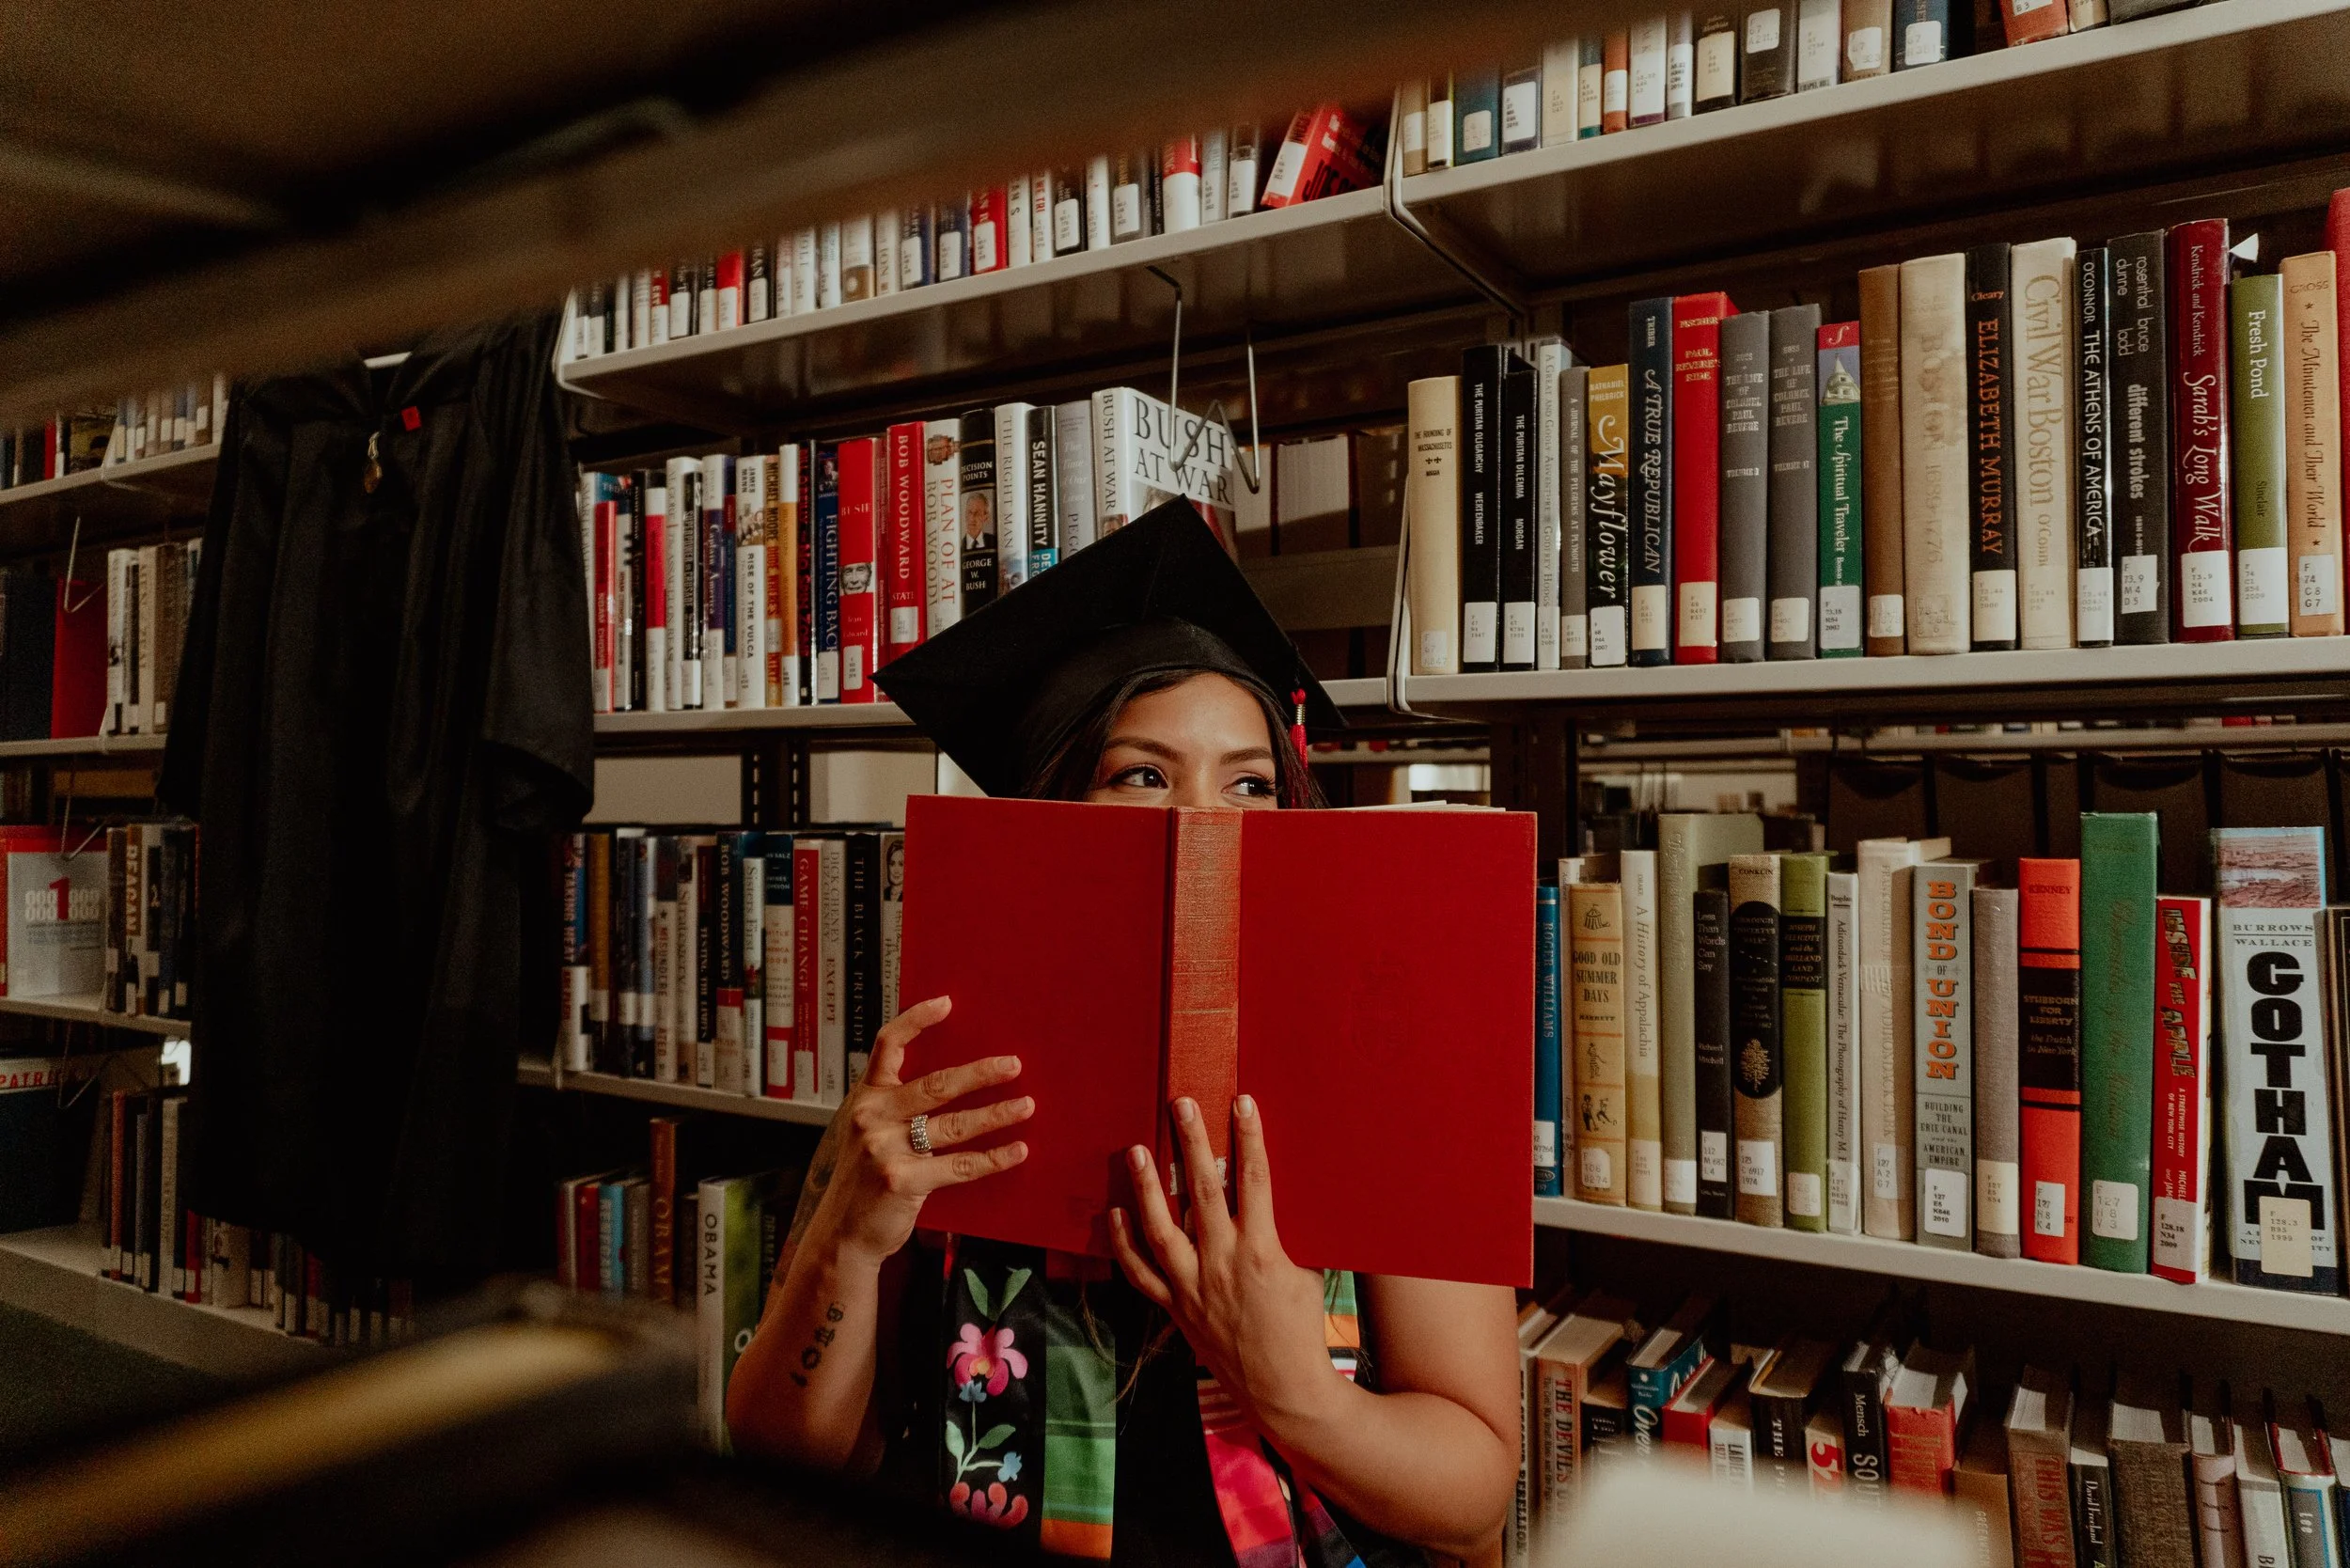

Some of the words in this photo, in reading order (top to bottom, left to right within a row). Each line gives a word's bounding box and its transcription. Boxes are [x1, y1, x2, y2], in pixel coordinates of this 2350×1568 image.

[2116, 258, 2133, 297] dunne
[2136, 256, 2154, 310] rosenthal
[2190, 244, 2204, 290] Kendrick
[2082, 261, 2096, 324] O'CONNOR
[2192, 292, 2204, 309] and
[2084, 329, 2101, 366] THE
[2117, 327, 2134, 357] ladd
[2137, 316, 2154, 353] bruce
[2192, 309, 2206, 357] Kendrick
[2248, 309, 2268, 355] Fresh
[2300, 320, 2320, 343] The
[1684, 348, 1713, 358] PAUL
[1774, 368, 1790, 379] THE
[1793, 364, 1811, 375] LIFE
[1474, 382, 1483, 398] THE
[1590, 379, 1625, 391] NATHANIEL
[1590, 390, 1625, 402] PHILBRICK
[1645, 368, 1662, 393] A
[1978, 318, 2001, 451] ELIZABETH
[2249, 358, 2269, 399] Pond
[2302, 347, 2321, 422] Minutemen
[1103, 394, 1115, 440] BUSH
[1474, 398, 1483, 431] PURITAN
[1780, 401, 1803, 414] PAUL
[2084, 369, 2102, 433] ATHENS
[2127, 384, 2149, 444] different
[2183, 371, 2218, 436] Sarah's
[1133, 395, 1229, 469] BUSH
[1515, 414, 1525, 430] THE
[1645, 394, 1662, 446] TRUE
[1834, 416, 1850, 442] The
[2304, 423, 2324, 447] and
[898, 434, 910, 468] BOB
[1032, 440, 1045, 479] SEAN
[1104, 446, 1115, 466] AT
[1418, 441, 1453, 452] MASSACHUSETTS
[1474, 431, 1484, 474] OLIGARCHY
[1515, 431, 1525, 463] PURITAN
[2083, 437, 2102, 461] OF
[2182, 444, 2217, 486] Long
[963, 471, 988, 482] POINTS
[1003, 455, 1013, 509] RIGHT
[1134, 447, 1165, 483] AT
[1175, 463, 1233, 506] WAR
[1515, 463, 1525, 499] DILEMMA
[1570, 460, 1578, 474] THE
[1831, 444, 1852, 501] Spiritual
[2128, 447, 2151, 500] strokes
[941, 478, 955, 533] PLAN
[1104, 471, 1117, 510] WAR
[1571, 477, 1579, 516] PILGRIMS
[1590, 414, 1629, 599] Mayflower
[1980, 455, 2003, 556] MURRAY
[2085, 464, 2103, 537] AMERICA
[2256, 479, 2267, 518] Sinclair
[2307, 485, 2326, 528] World
[899, 474, 910, 579] WOODWARD
[1033, 483, 1048, 546] HANNITY
[1474, 492, 1484, 545] WERTENBAKER
[1639, 448, 1663, 574] REPUBLICAN
[1834, 504, 1850, 554] Traveler
[2187, 484, 2221, 553] Walk
[1003, 513, 1013, 548] MAN
[1515, 518, 1525, 550] MORGAN
[941, 541, 955, 570] OF
[962, 557, 993, 570] GEORGE
[1571, 533, 1579, 572] PLYMOUTH
[747, 582, 754, 595] OF
[965, 581, 986, 591] BUSH
[720, 844, 729, 877] BOB
[2029, 885, 2074, 895] KENNEY
[1637, 905, 1649, 917] A
[1697, 924, 1719, 933] Than
[1926, 880, 1959, 961] BOND
[2232, 923, 2314, 932] BURROWS
[720, 882, 730, 981] WOODWARD
[1543, 922, 1555, 967] ROGER
[1634, 921, 1650, 973] History
[1699, 935, 1726, 946] Words
[1837, 919, 1847, 969] Adirondack
[2234, 938, 2313, 947] WALLACE
[1573, 951, 1596, 964] GOOD
[1601, 951, 1622, 965] OLD
[1697, 949, 1716, 958] Can
[1698, 961, 1714, 971] Say
[1936, 965, 1948, 975] OF
[1575, 969, 1618, 984] SUMMER
[1638, 974, 1651, 990] of
[1543, 972, 1556, 1039] WILLIAMS
[1583, 989, 1610, 1003] DAYS
[2040, 1006, 2062, 1015] FOR
[1634, 991, 1653, 1058] Appalachia
[1837, 1023, 1848, 1041] The
[1926, 979, 1959, 1081] UNION
[1835, 1043, 1847, 1100] Photography
[1838, 1101, 1847, 1110] of
[1924, 1101, 1965, 1114] BUILDING
[1936, 1114, 1952, 1123] THE
[2178, 1094, 2186, 1133] STREETWISE
[1836, 1110, 1848, 1139] Henry
[1920, 1122, 1940, 1134] ERIE
[1942, 1124, 1968, 1136] CANAL
[1923, 1144, 1966, 1156] AMERICAN
[1929, 1154, 1960, 1167] EMPIRE
[704, 1213, 718, 1296] OBAMA
[1555, 1378, 1573, 1415] THE
[1854, 1393, 1870, 1437] Mensch
[1771, 1419, 1784, 1457] THE
[2085, 1479, 2099, 1508] David
[2087, 1507, 2104, 1545] Freeland
